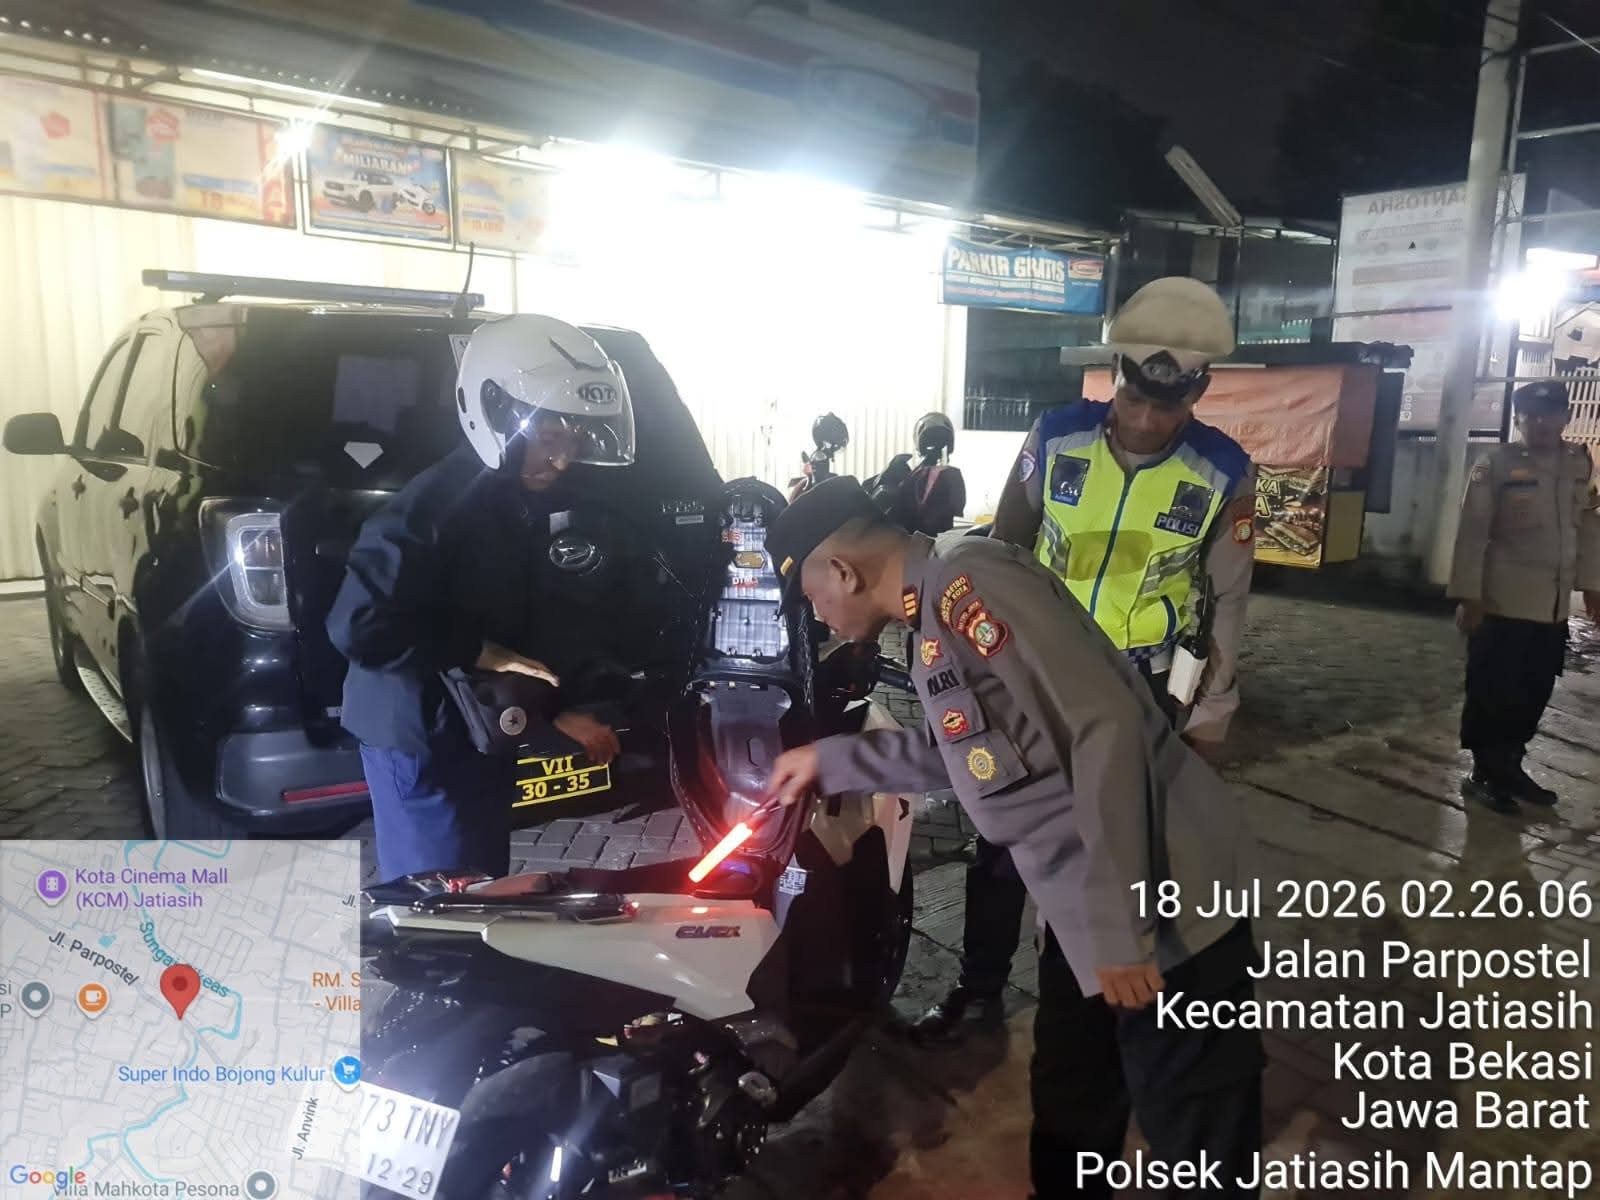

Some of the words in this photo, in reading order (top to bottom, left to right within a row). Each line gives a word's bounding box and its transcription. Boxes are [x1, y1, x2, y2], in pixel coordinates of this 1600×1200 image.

[949, 247, 1010, 278] PARKIR
[1014, 255, 1065, 283] GRATIS
[1157, 514, 1200, 537] POLISI
[945, 576, 967, 598] METRO
[541, 755, 574, 776] VII
[522, 781, 548, 801] 30
[566, 772, 591, 792] 35
[403, 1104, 456, 1150] TNY
